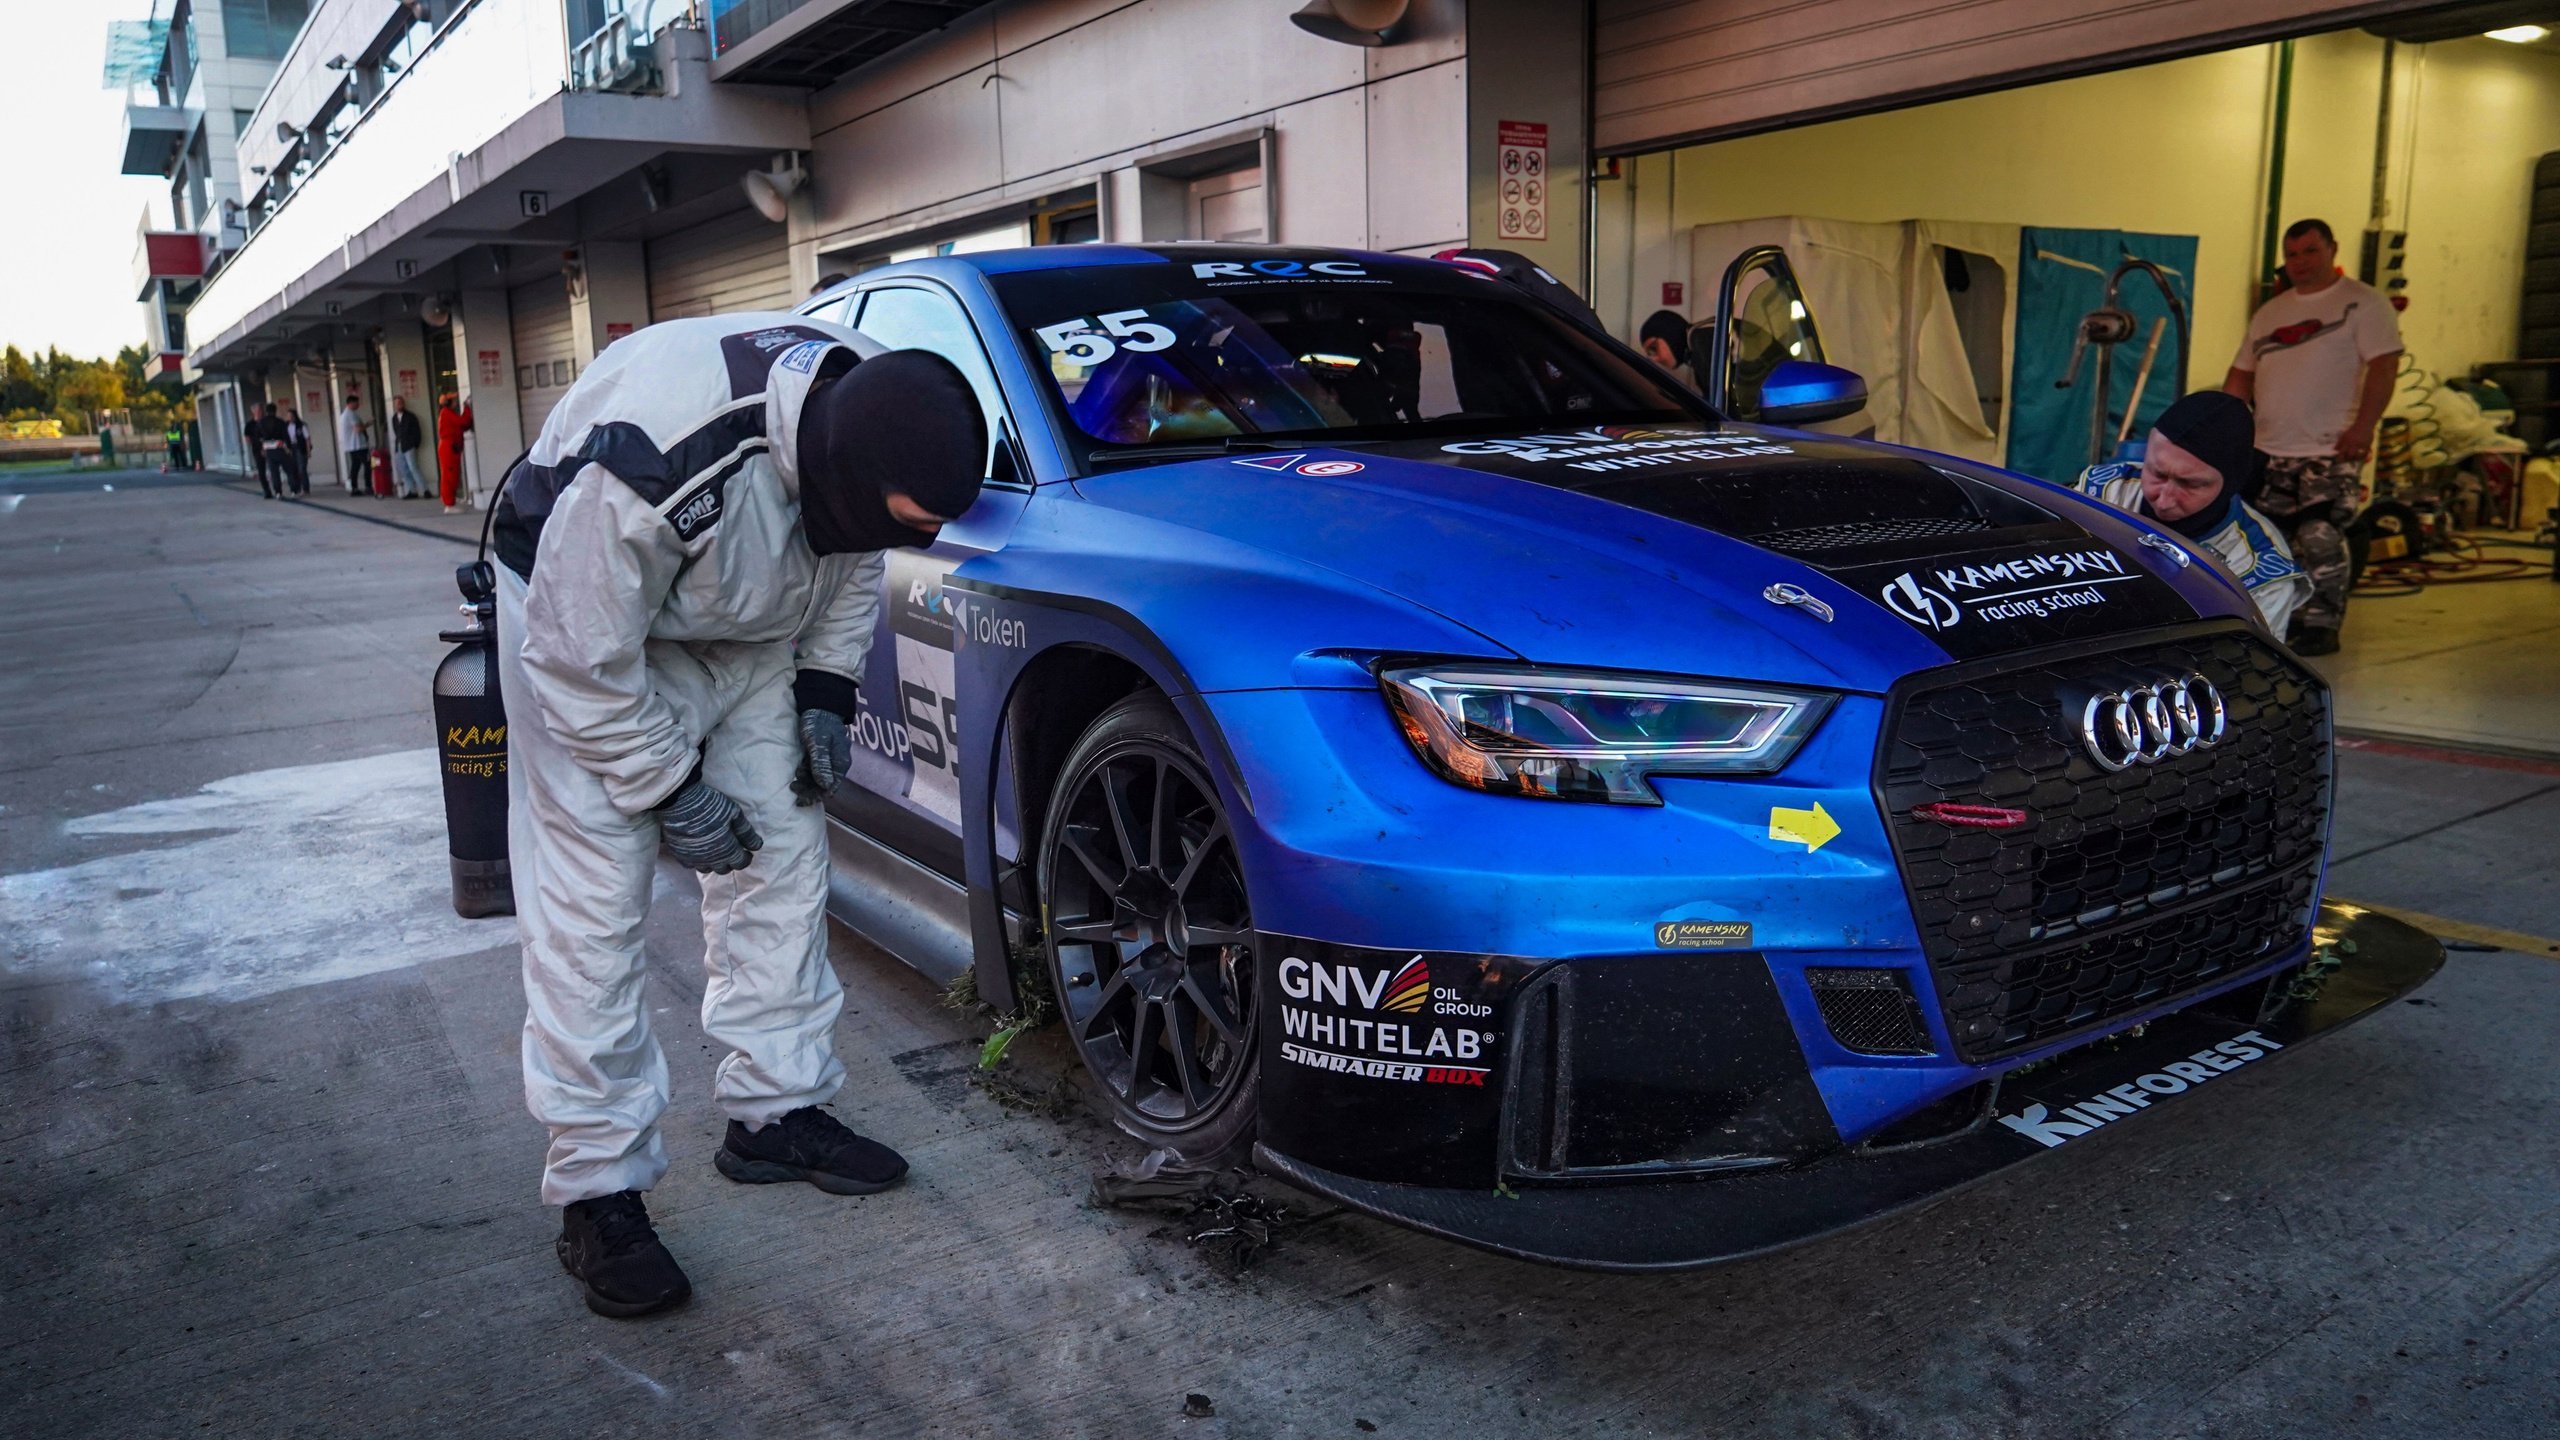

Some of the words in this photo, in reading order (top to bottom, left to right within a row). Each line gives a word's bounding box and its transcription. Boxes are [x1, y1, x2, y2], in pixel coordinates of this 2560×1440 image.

[529, 196, 541, 213] 6
[1036, 309, 1176, 366] 55
[1441, 426, 1613, 454] GNV
[1507, 436, 1769, 462] KINFOREST
[678, 493, 716, 530] OMP
[1935, 550, 2125, 592] KAMENSKIY
[1977, 598, 2047, 622] racing
[2042, 586, 2106, 611] school
[970, 605, 1026, 649] Token
[846, 711, 911, 762] ROUP
[448, 760, 493, 777] racing
[1678, 938, 1700, 947] racing
[1701, 938, 1725, 946] school
[1680, 924, 1749, 936] KAMENSKIY
[1279, 956, 1391, 1010] GNV
[1433, 987, 1461, 1000] OIL
[1433, 1002, 1492, 1017] GROUP
[1280, 1041, 1423, 1081] SIMRACER
[1426, 1067, 1488, 1086] BOX
[1997, 1030, 2284, 1147] KINFOREST
